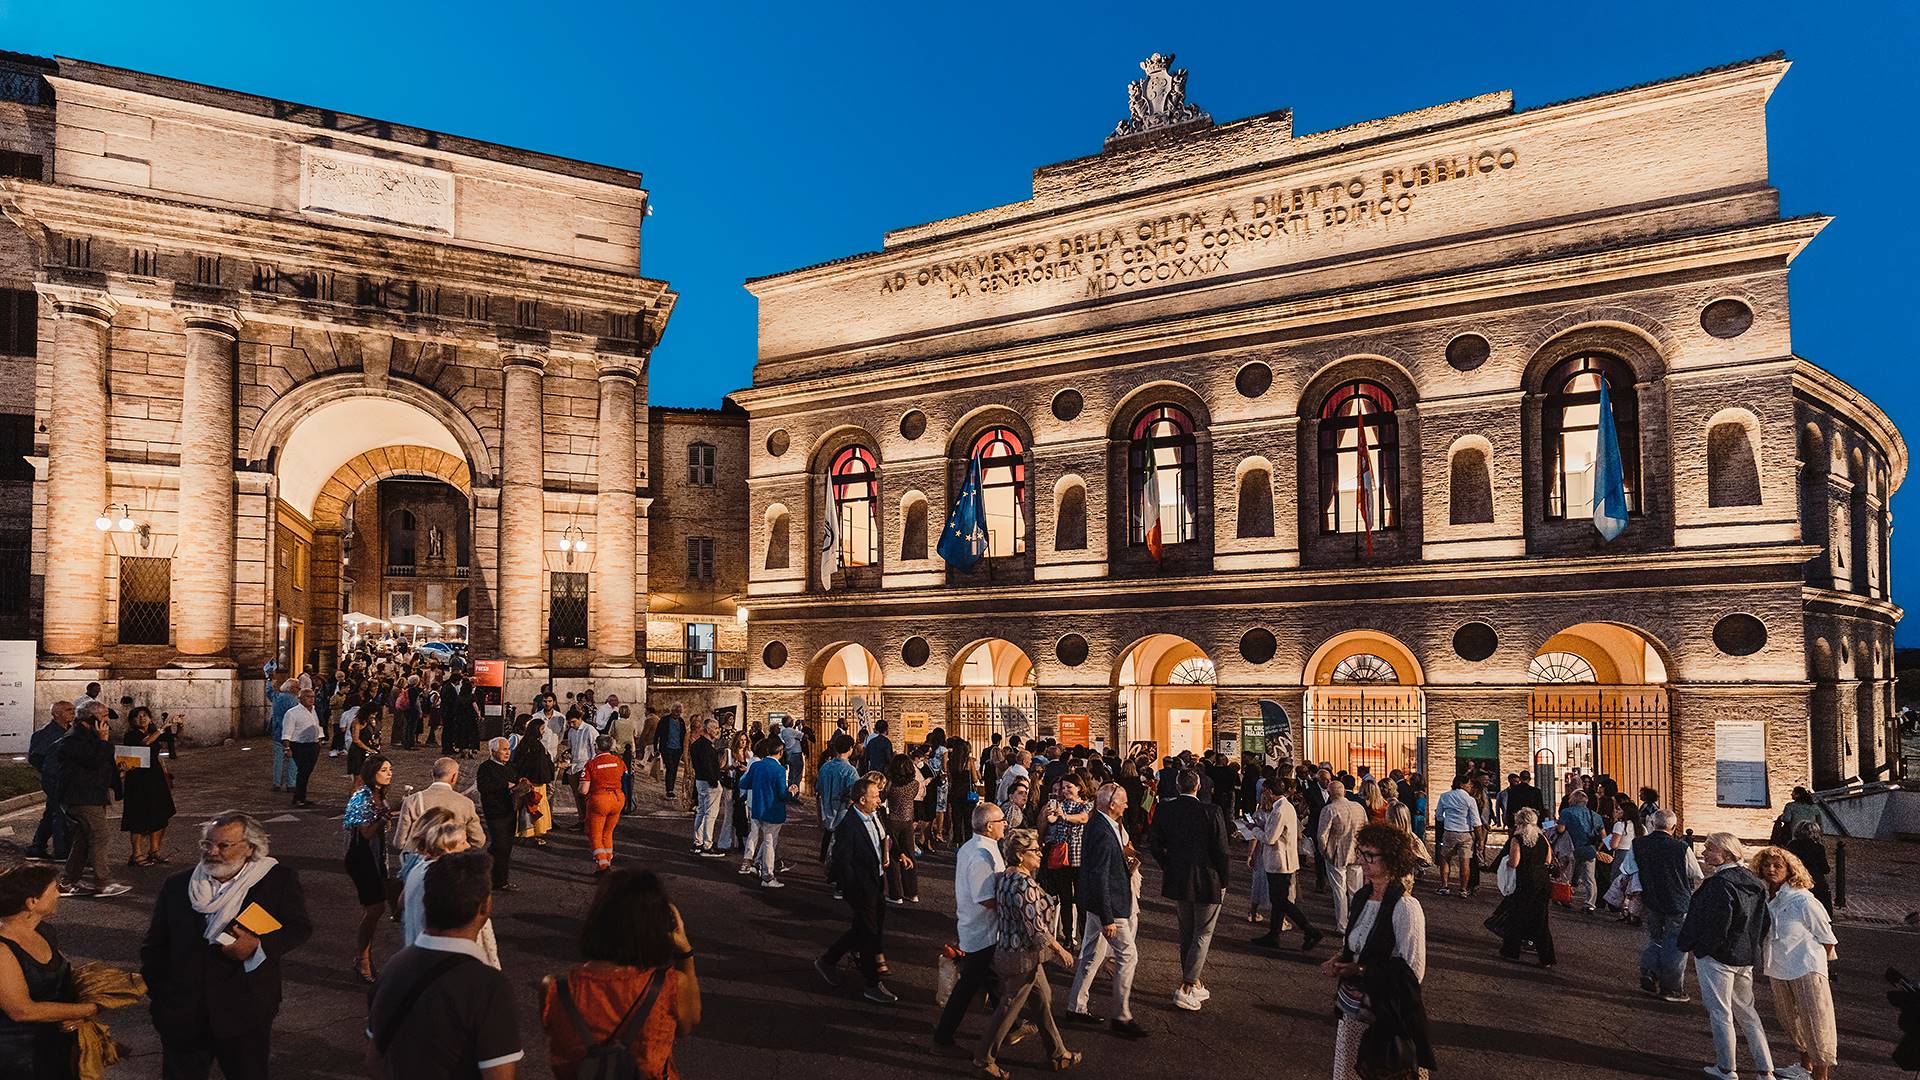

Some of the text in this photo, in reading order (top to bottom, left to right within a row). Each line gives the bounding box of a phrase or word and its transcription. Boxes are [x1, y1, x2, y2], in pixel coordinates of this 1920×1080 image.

[880, 273, 906, 296] AD
[918, 247, 1047, 286] ORNAMENTO
[1059, 231, 1125, 259] DELLA
[1222, 207, 1238, 225] A
[1253, 178, 1365, 219] DILETTO
[1382, 148, 1518, 193] PUBBLICO
[950, 282, 971, 299] LA
[1094, 254, 1110, 272] DI
[1122, 240, 1188, 265] CENTO
[1201, 214, 1309, 249] CONSORTI
[1085, 250, 1229, 296] MDCCCXXIX
